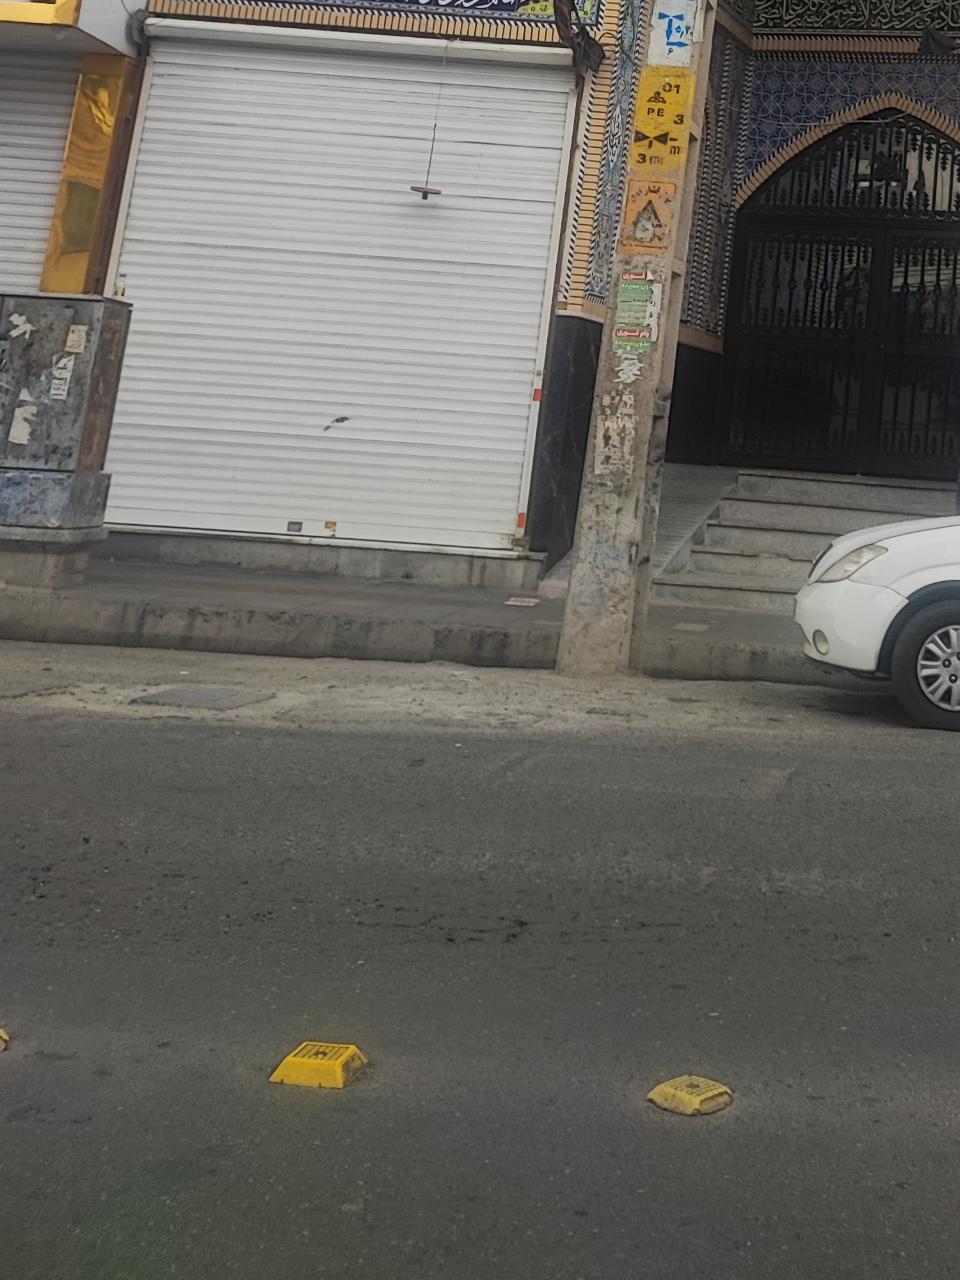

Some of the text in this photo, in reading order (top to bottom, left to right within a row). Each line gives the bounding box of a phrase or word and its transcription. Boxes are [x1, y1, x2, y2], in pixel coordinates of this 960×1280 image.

[647, 108, 665, 117] PE
[673, 114, 685, 125] 3
[636, 153, 647, 164] 3
